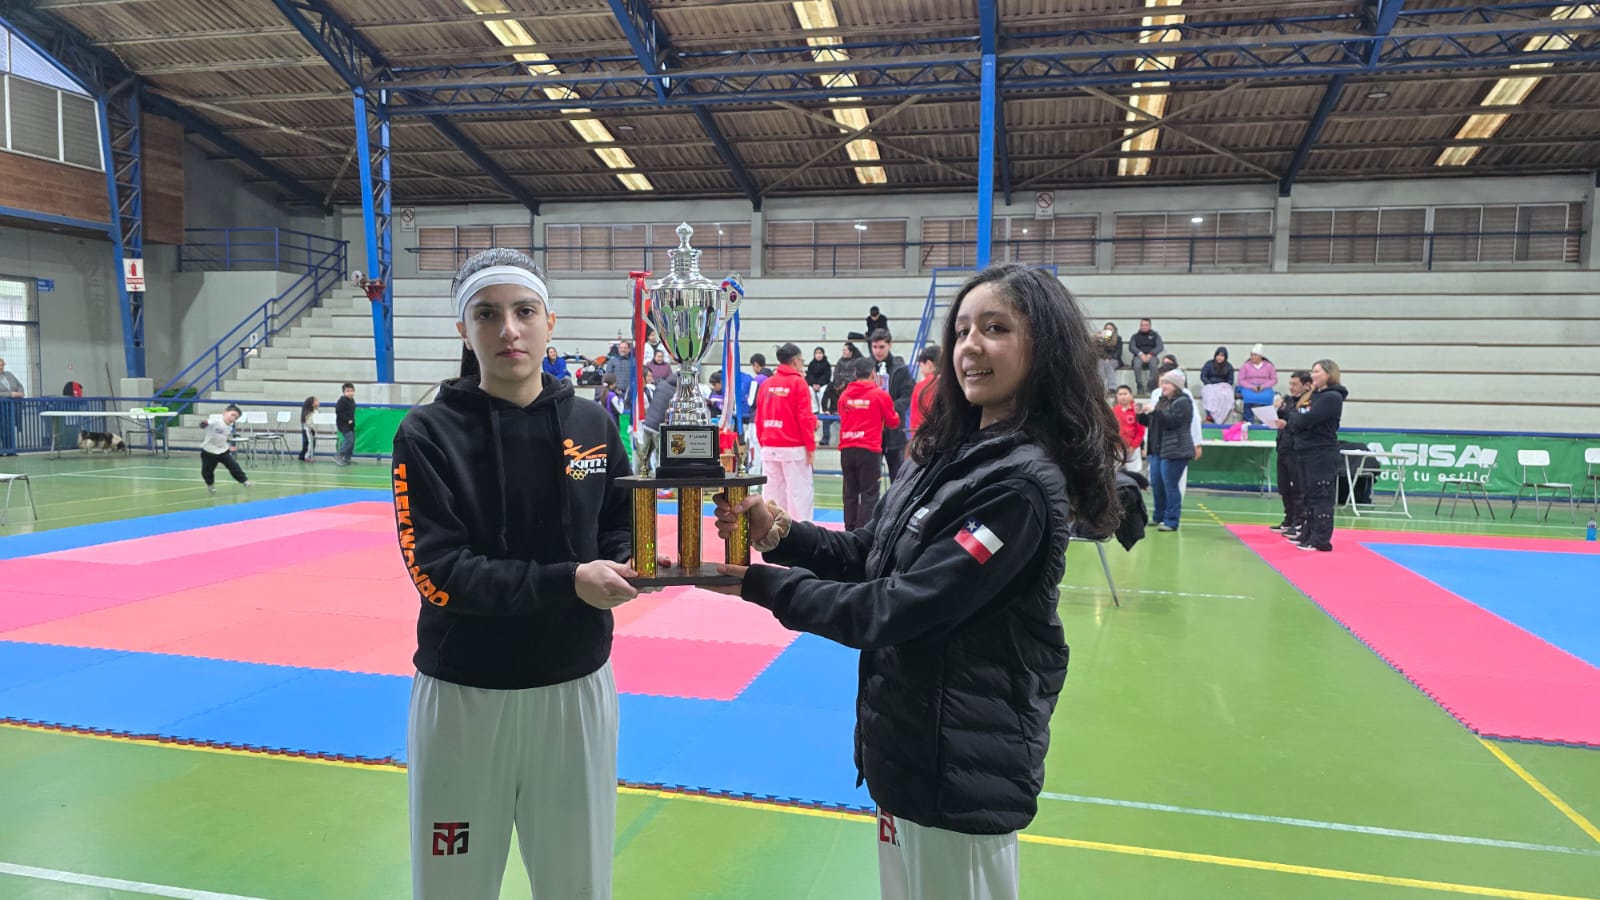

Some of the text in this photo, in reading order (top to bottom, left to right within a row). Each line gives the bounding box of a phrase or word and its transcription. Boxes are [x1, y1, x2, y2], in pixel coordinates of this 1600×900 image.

[1375, 469, 1406, 482] do,
[1413, 470, 1430, 481] tu
[394, 463, 449, 607] TAEKWONDO
